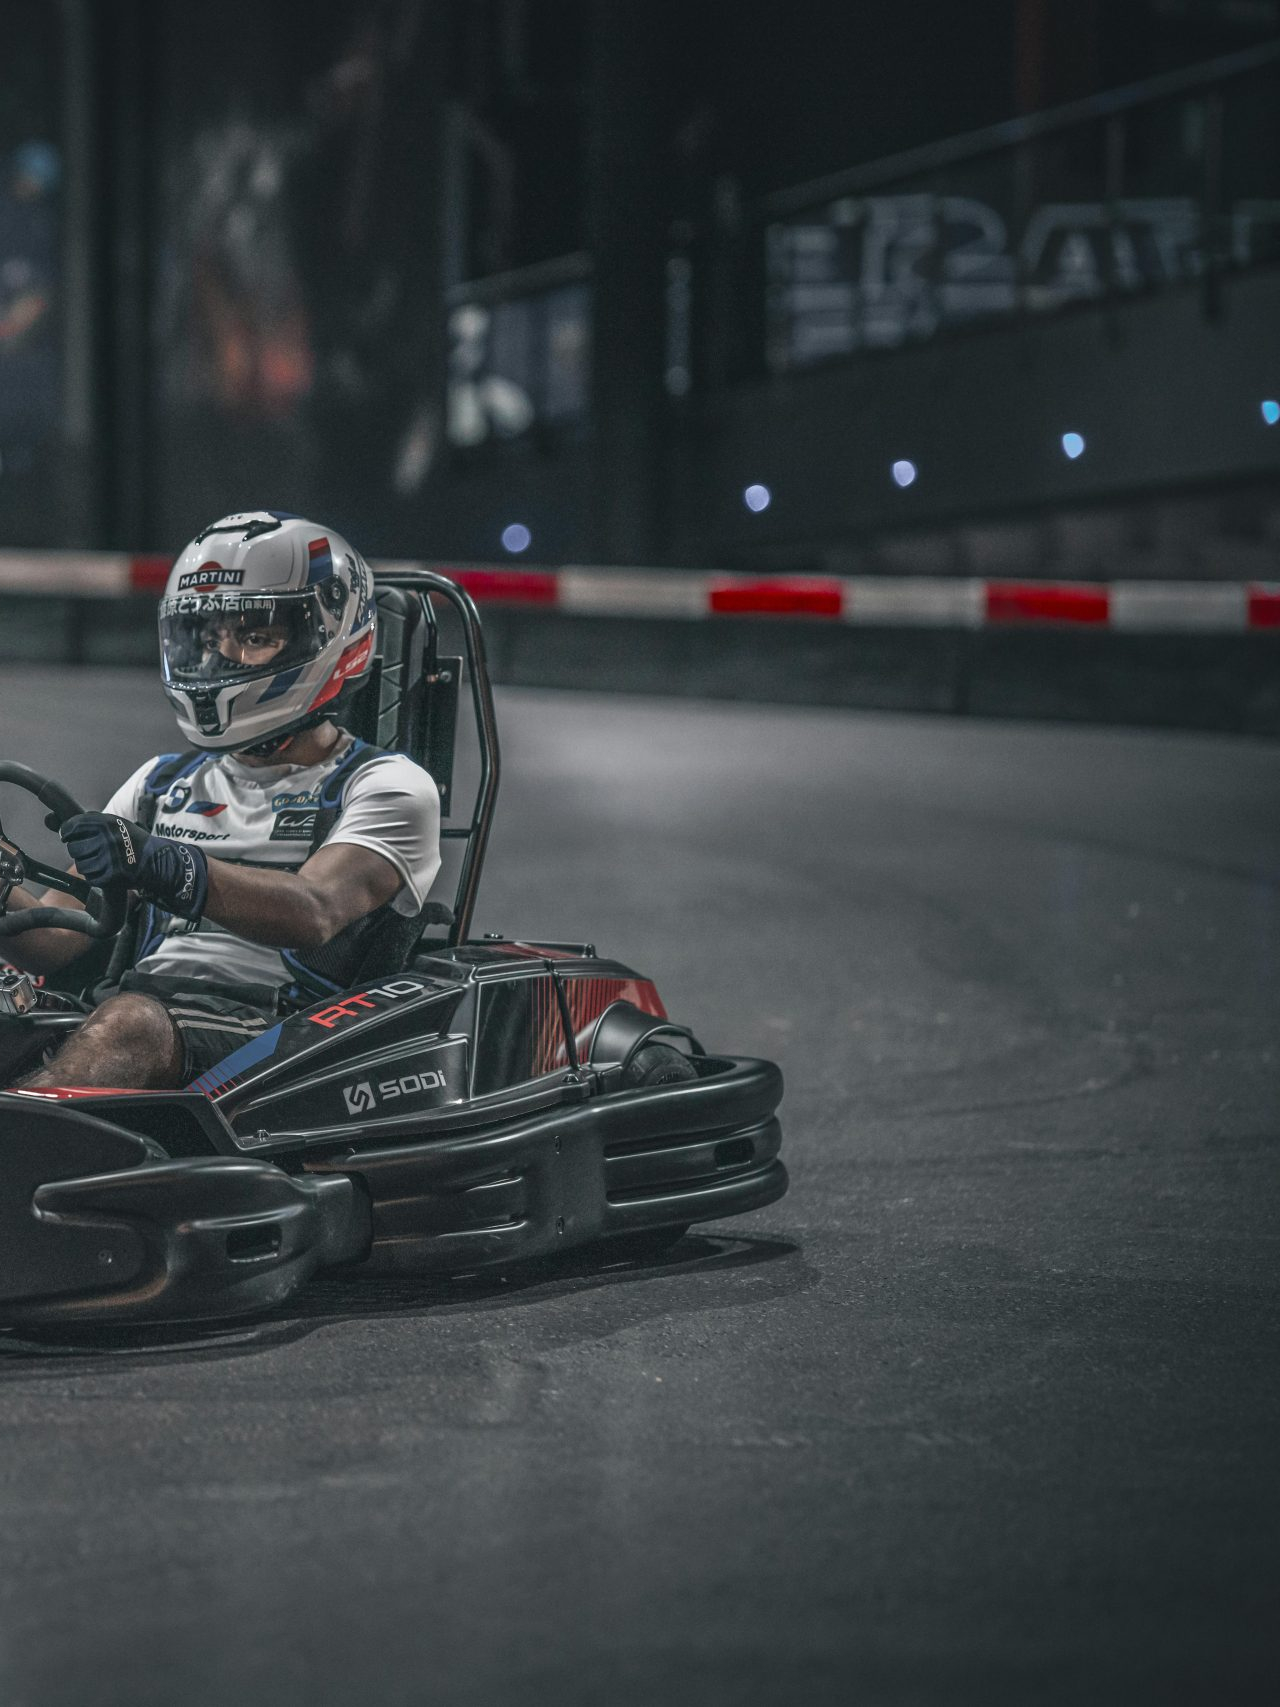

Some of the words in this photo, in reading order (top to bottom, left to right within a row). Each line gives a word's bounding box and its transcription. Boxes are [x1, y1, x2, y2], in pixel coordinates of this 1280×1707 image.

[180, 571, 241, 588] MARTINI
[116, 818, 136, 865] sparco
[156, 823, 231, 841] Motorsport
[176, 845, 197, 901] sparco
[307, 980, 425, 1029] RT10
